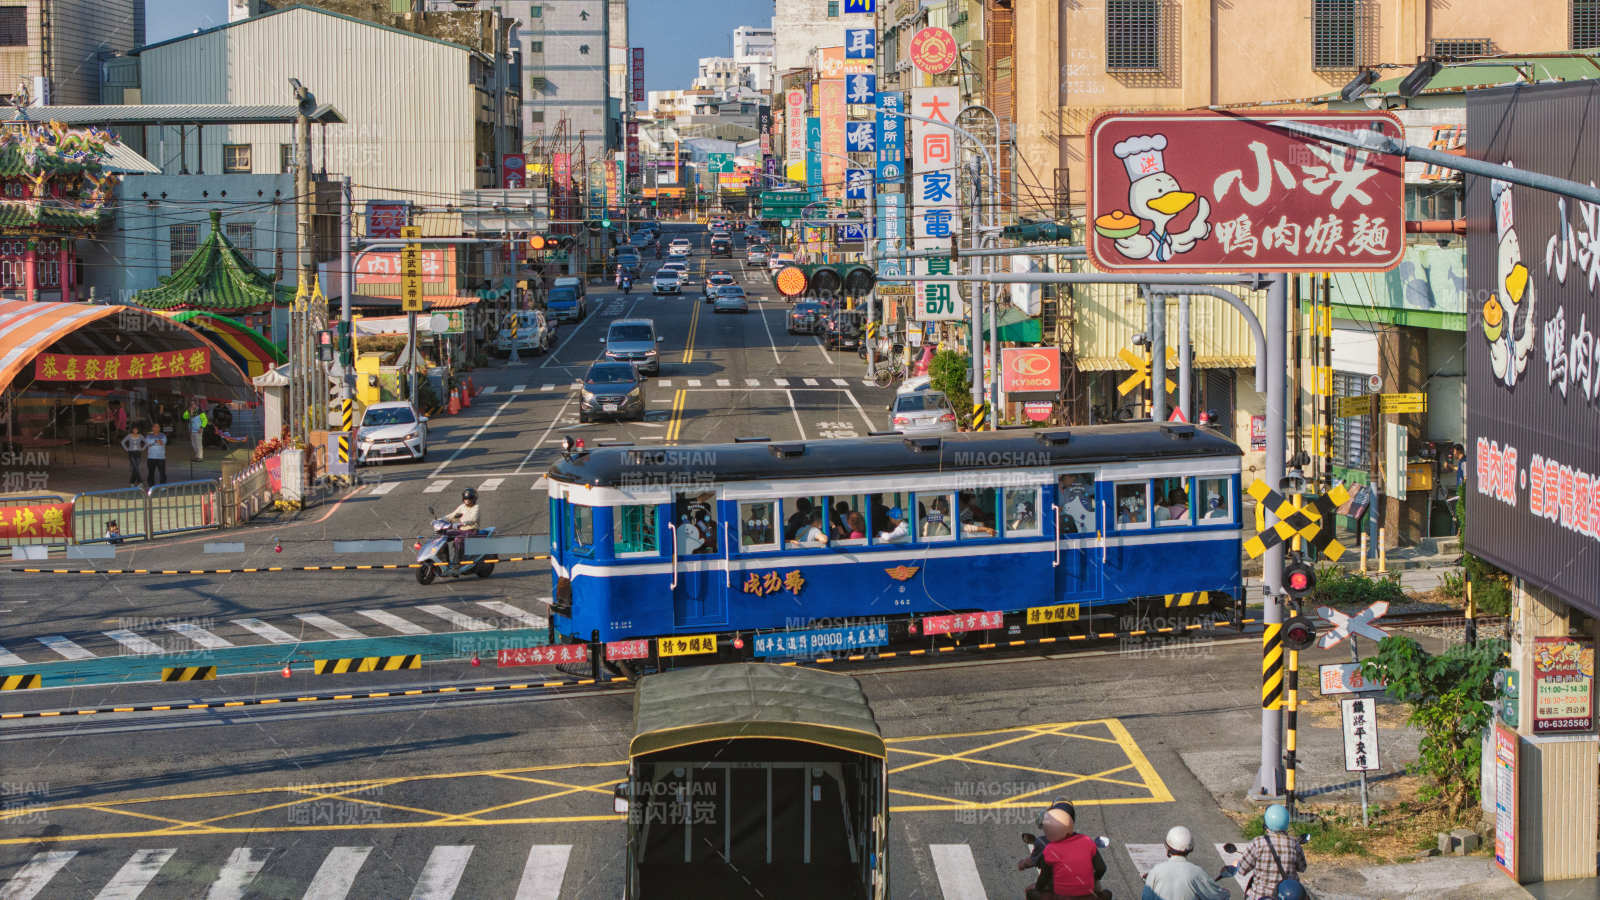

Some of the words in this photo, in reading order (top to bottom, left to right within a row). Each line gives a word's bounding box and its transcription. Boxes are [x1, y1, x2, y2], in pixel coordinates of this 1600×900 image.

[1544, 305, 1600, 401] 鴨肉
[41, 354, 121, 381] 恭喜發財
[127, 349, 207, 378] 新年快樂
[1011, 378, 1052, 388] KYMCO
[0, 508, 66, 537] 快樂
[811, 632, 844, 648] 90000
[1538, 718, 1590, 729] 06-6325566
